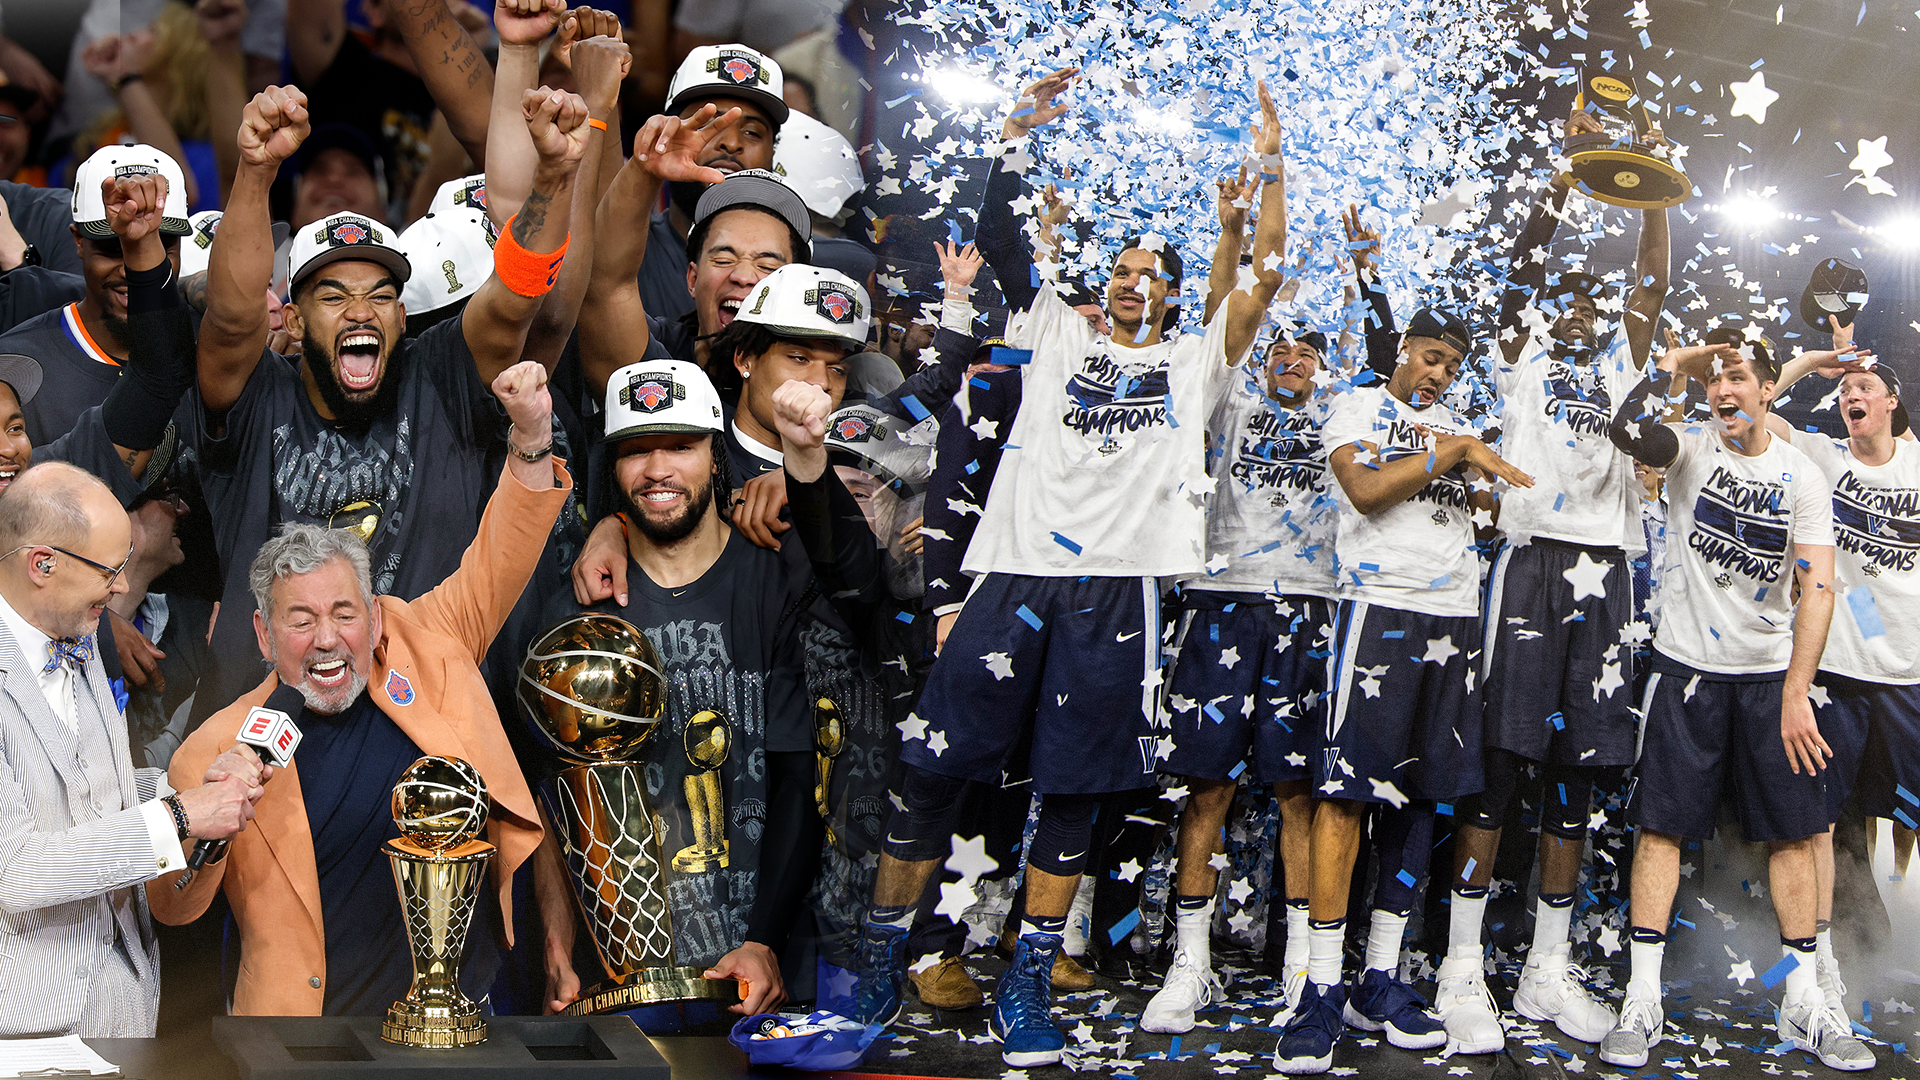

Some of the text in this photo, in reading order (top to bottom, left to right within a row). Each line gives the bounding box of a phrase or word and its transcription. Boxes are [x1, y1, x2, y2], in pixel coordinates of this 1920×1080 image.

[732, 50, 761, 65] CHAMPIONS
[1596, 83, 1632, 96] NCAA
[116, 166, 158, 176] NBA CHAMPIONS
[327, 216, 370, 227] NBA CHAMPIONS
[820, 282, 856, 298] NBA CHAMPIONS
[630, 373, 672, 384] NBA CHAMPIONS
[848, 410, 878, 422] CHAMPIONS
[1706, 466, 1790, 516] NATIONAL
[1837, 470, 1920, 518] NATIONAL
[1688, 530, 1781, 583] CHAMPIONS
[595, 983, 655, 1010] CHAMPIONS
[403, 1031, 430, 1044] FINALS
[432, 1032, 455, 1044] MOST
